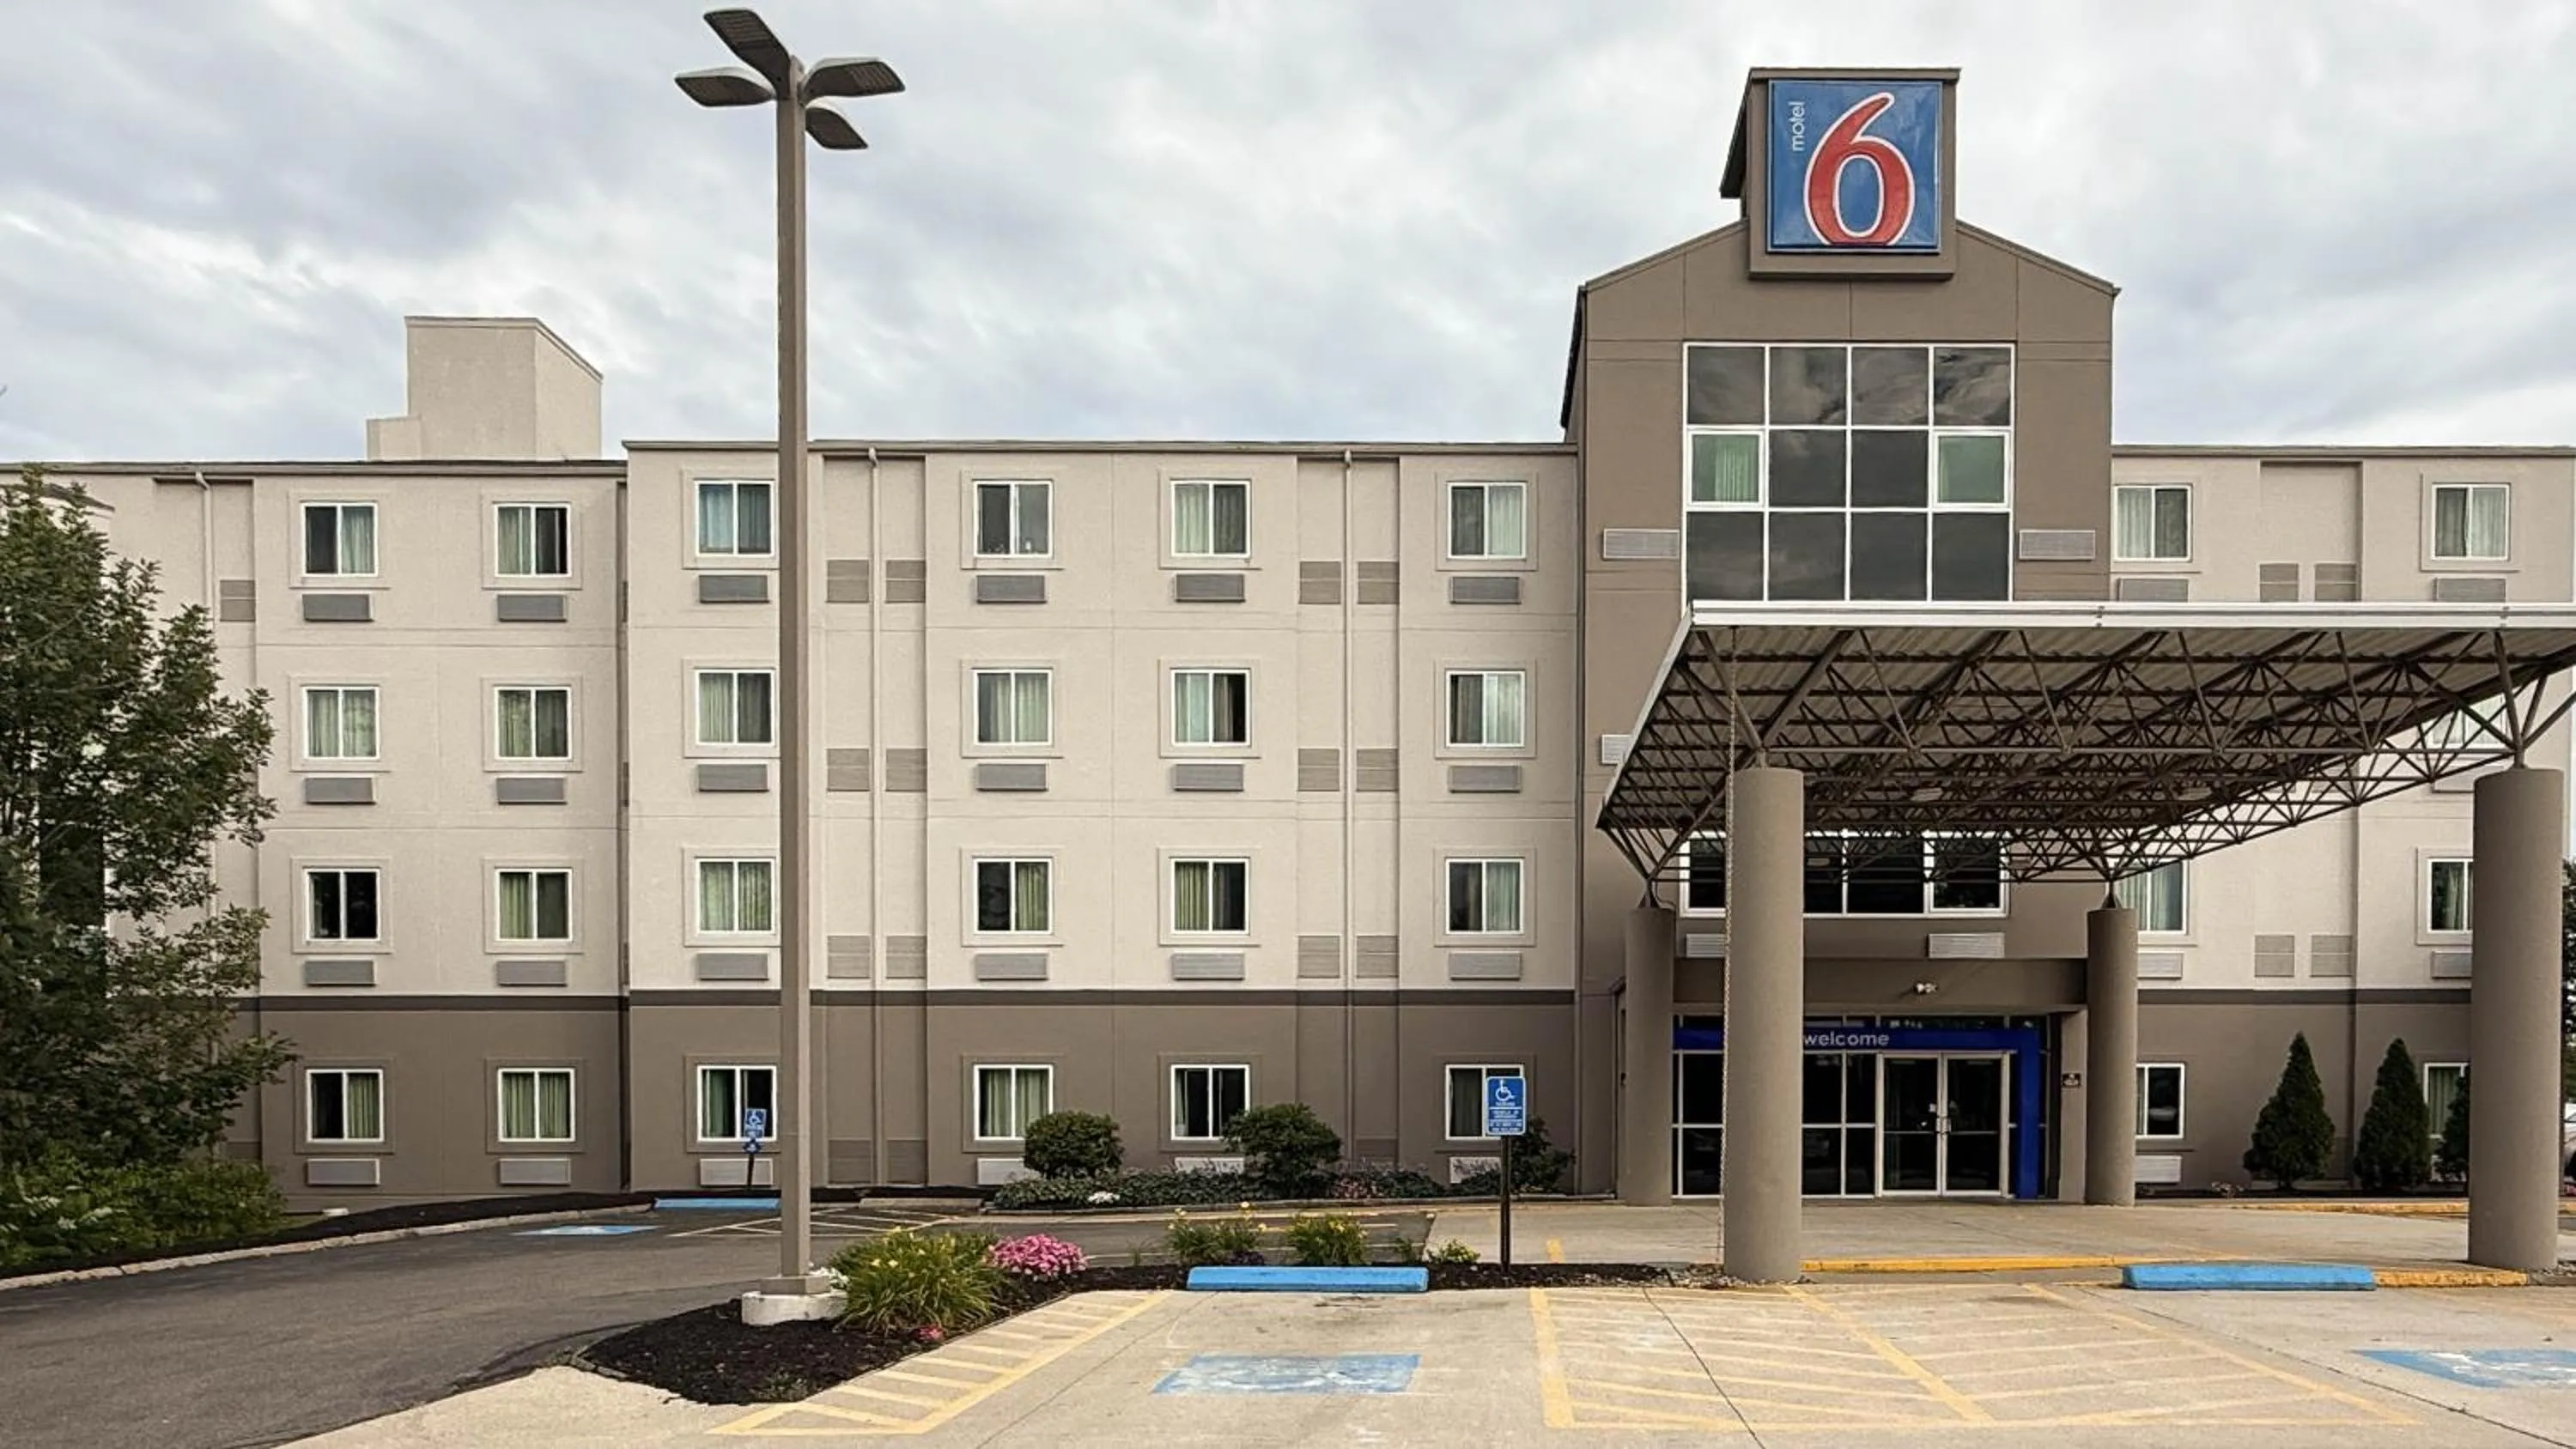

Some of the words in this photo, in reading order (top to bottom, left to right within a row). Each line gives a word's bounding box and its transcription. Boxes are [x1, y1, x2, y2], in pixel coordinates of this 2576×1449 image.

[1788, 101, 1805, 151] motel
[1804, 92, 1915, 246] 6
[1803, 1030, 1890, 1046] welcome
